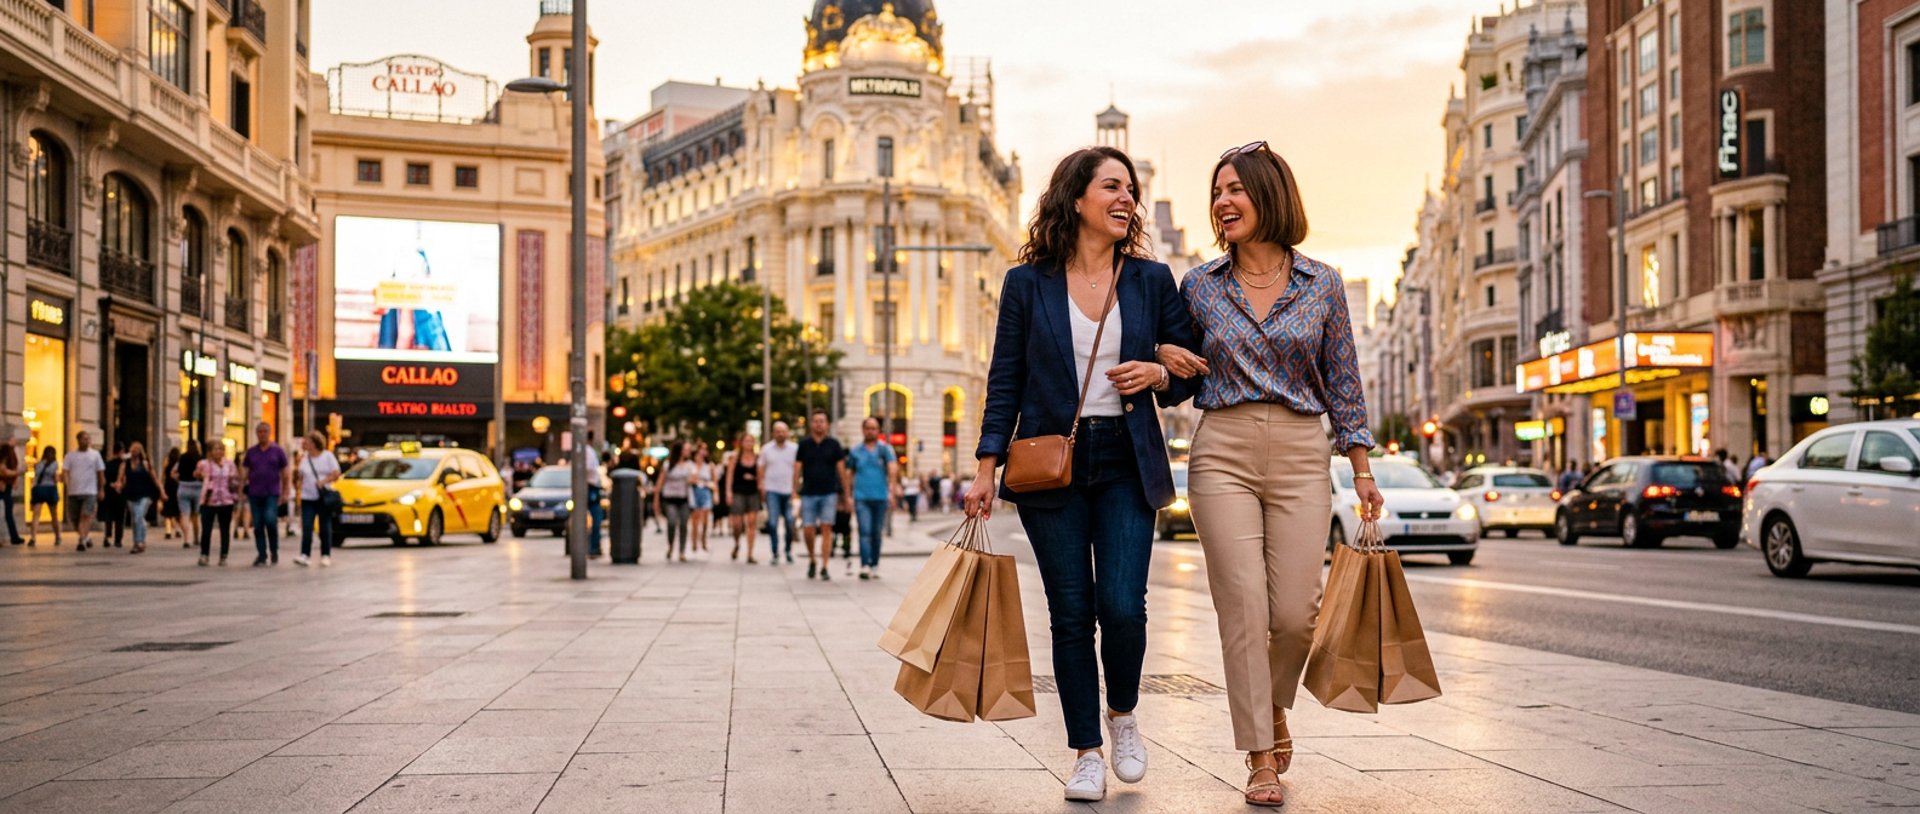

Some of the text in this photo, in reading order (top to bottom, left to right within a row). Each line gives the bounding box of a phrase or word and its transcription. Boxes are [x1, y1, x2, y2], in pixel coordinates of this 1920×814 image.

[386, 62, 443, 77] TEATRO
[372, 75, 456, 97] CALLAO
[1718, 90, 1738, 172] fnac
[381, 365, 459, 386] CALLAO
[377, 401, 428, 415] TEATRO
